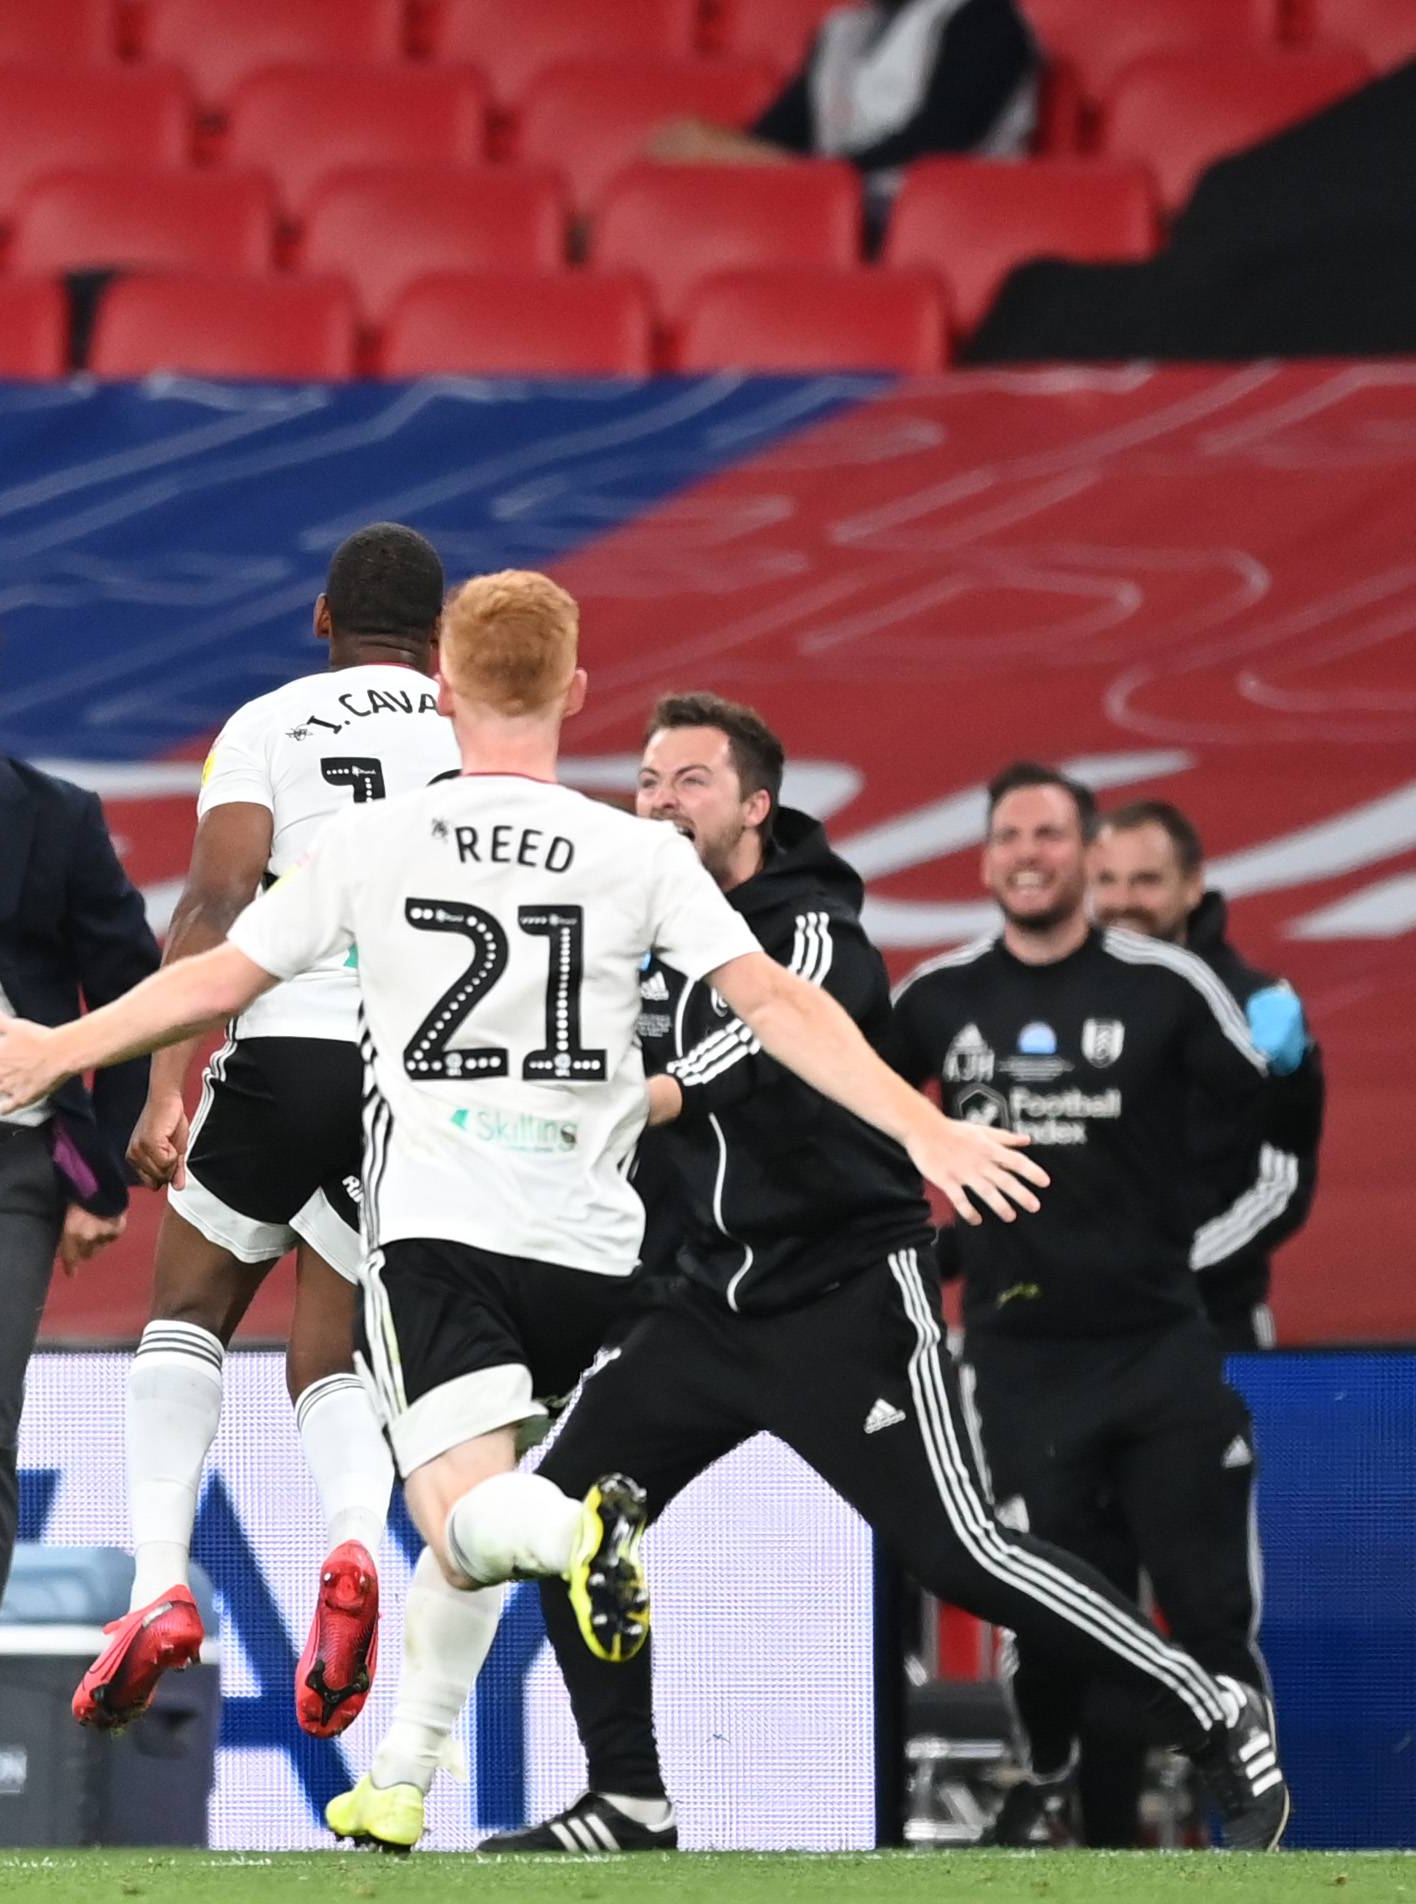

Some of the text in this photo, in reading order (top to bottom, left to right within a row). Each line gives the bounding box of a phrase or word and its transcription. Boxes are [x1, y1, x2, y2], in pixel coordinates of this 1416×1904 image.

[455, 825, 575, 873] REED
[403, 896, 607, 1082] 21
[1010, 1086, 1123, 1120] Football
